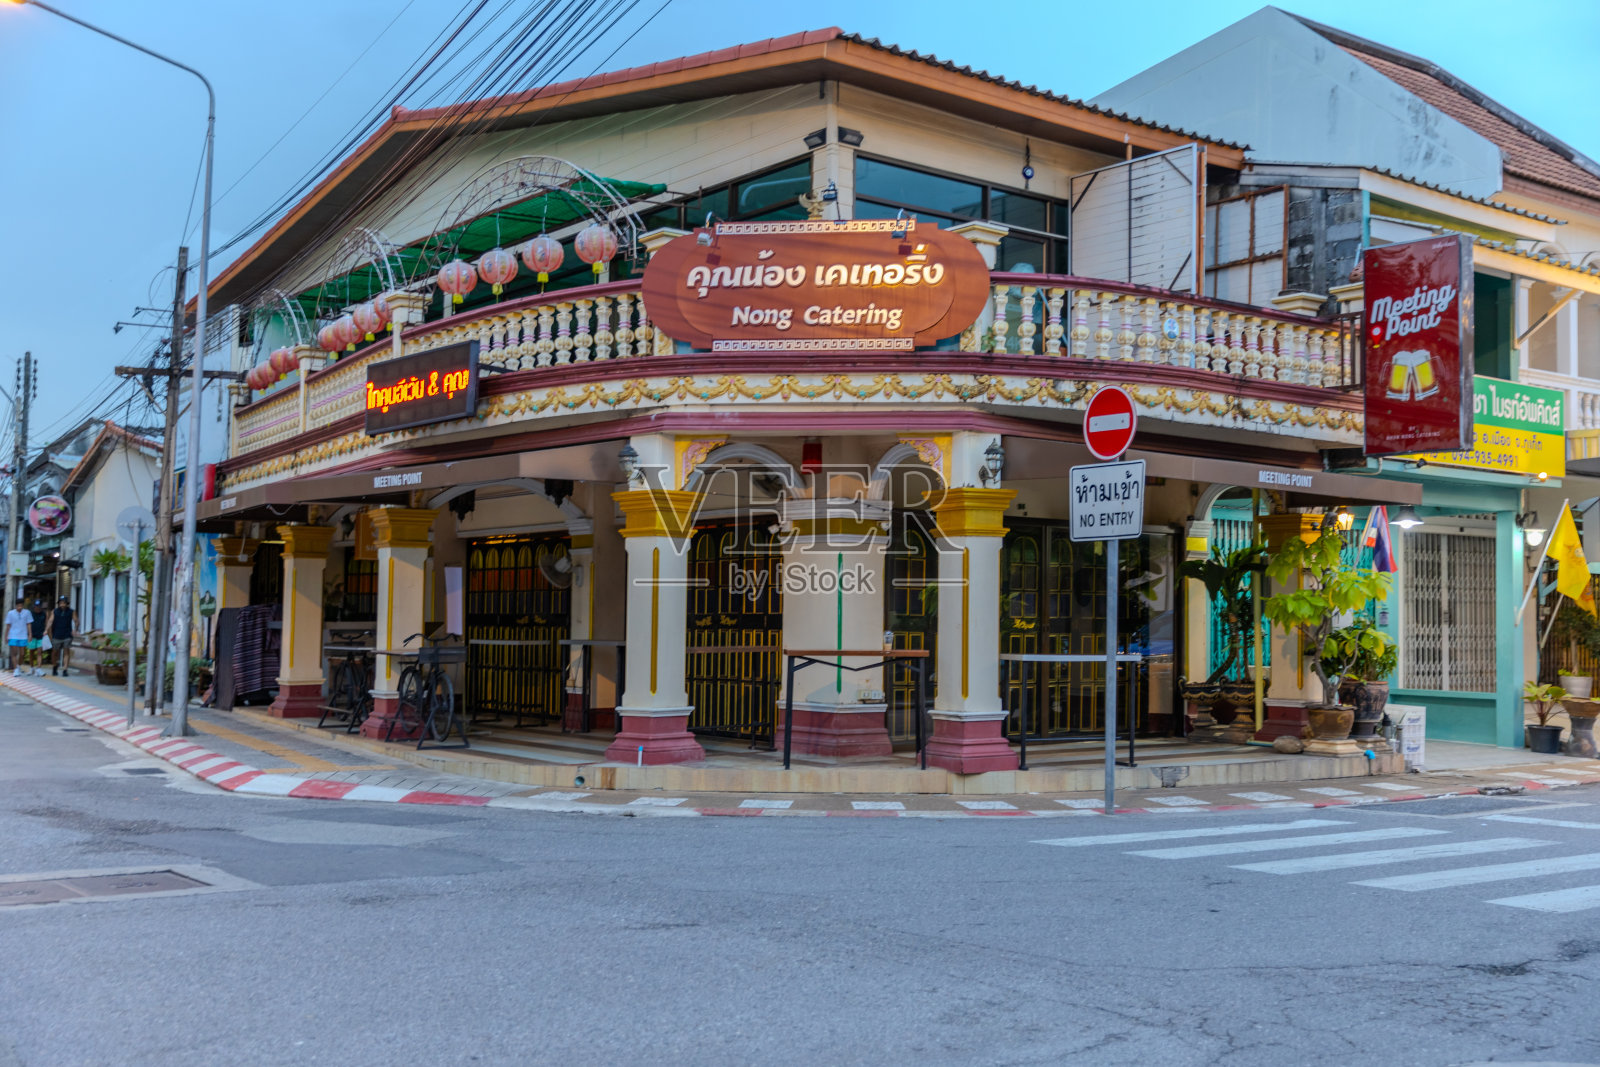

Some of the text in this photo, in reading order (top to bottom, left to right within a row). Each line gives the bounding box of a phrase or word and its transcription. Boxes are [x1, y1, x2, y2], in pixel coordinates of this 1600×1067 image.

[687, 244, 944, 298] คุณน้อง เคเทอริ่ง
[731, 303, 903, 331] Nong Catering
[1370, 285, 1457, 324] Meeting
[1385, 305, 1441, 341] Point
[427, 371, 439, 396] &
[374, 472, 423, 488] MEETING POINT
[1075, 470, 1140, 503] ห้ามเข้า
[1259, 470, 1313, 487] MEETING POINT
[1080, 511, 1135, 527] NO ENTRY
